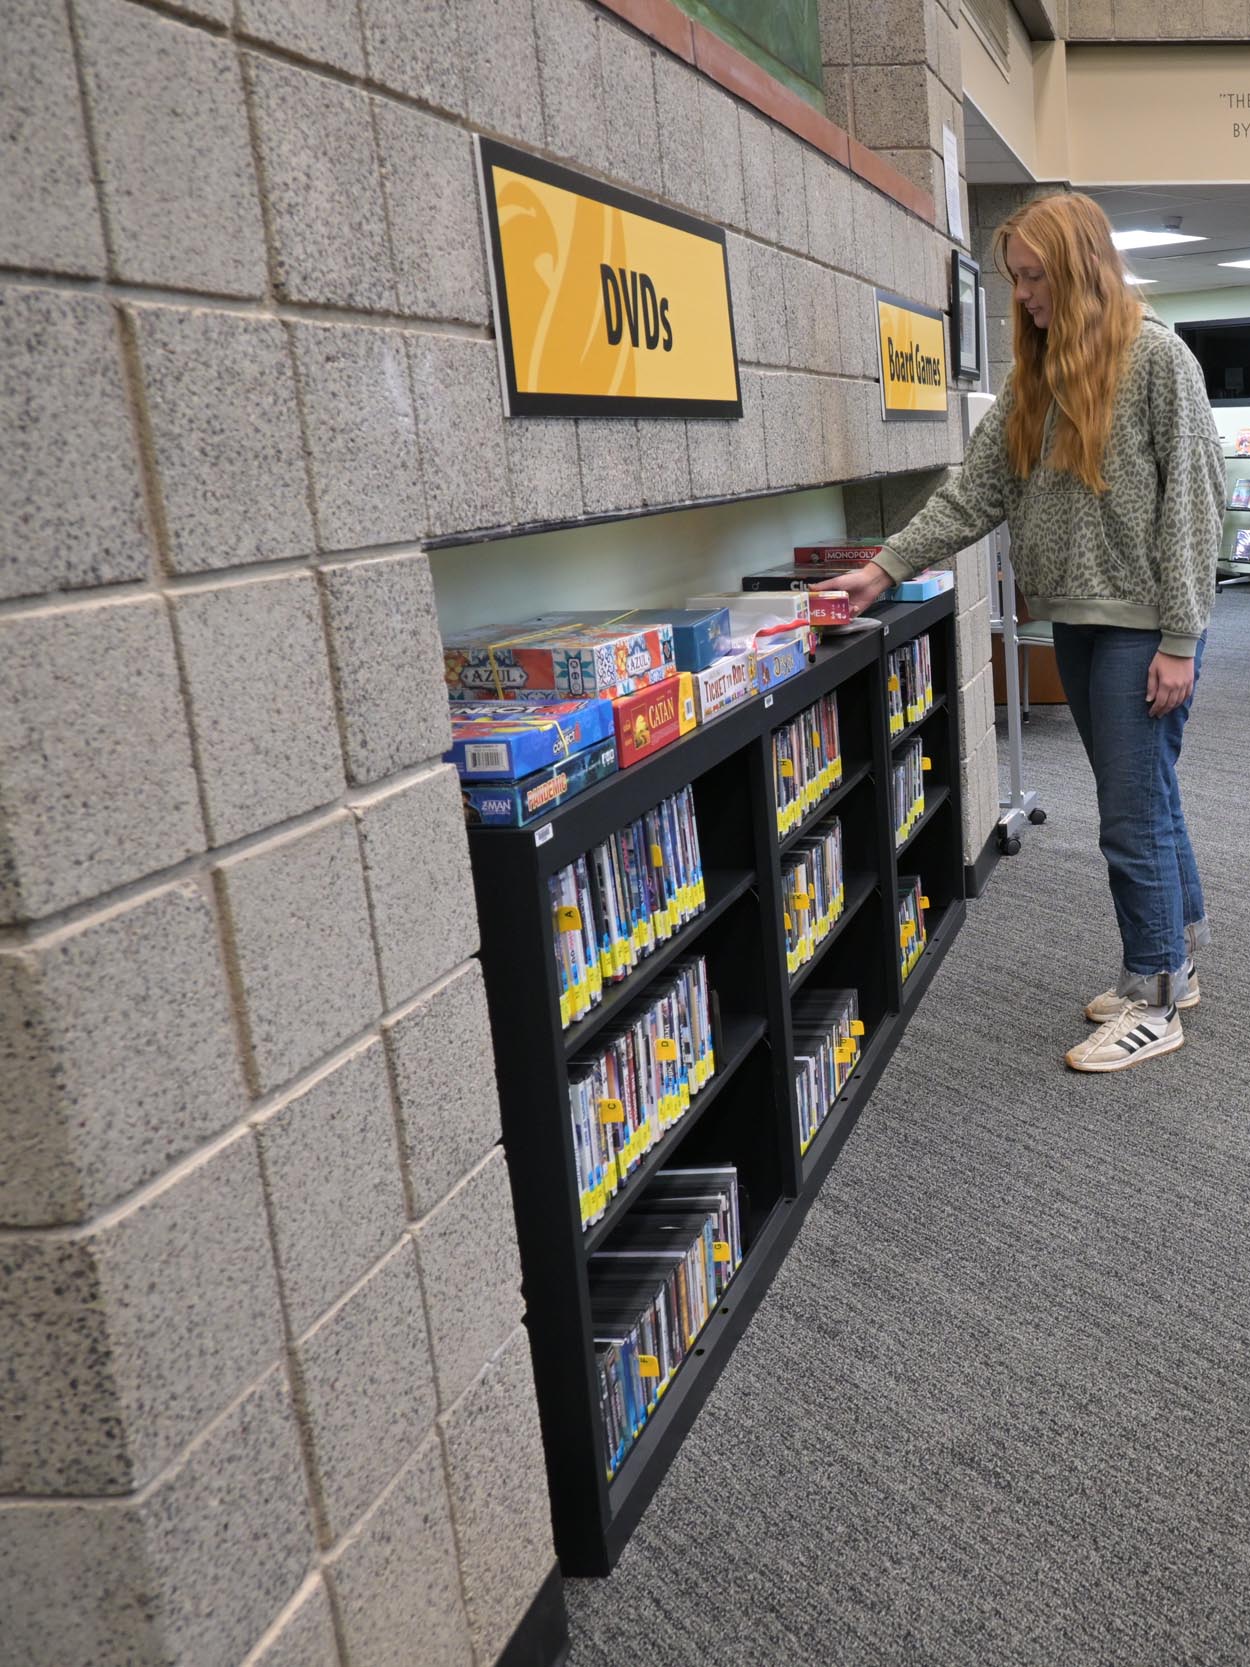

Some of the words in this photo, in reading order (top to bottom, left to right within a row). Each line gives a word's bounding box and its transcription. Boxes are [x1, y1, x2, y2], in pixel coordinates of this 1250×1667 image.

[1233, 122, 1250, 138] BY
[600, 263, 673, 352] DVDs
[888, 336, 915, 384] Board
[915, 343, 941, 387] Games
[826, 551, 876, 561] MONOPOLY
[471, 669, 517, 683] AZUL
[629, 656, 650, 671] AZUL
[703, 675, 727, 703] TICKET
[731, 664, 746, 686] RIDE
[648, 697, 675, 729] CATAN
[527, 773, 568, 812] PANDEMIC
